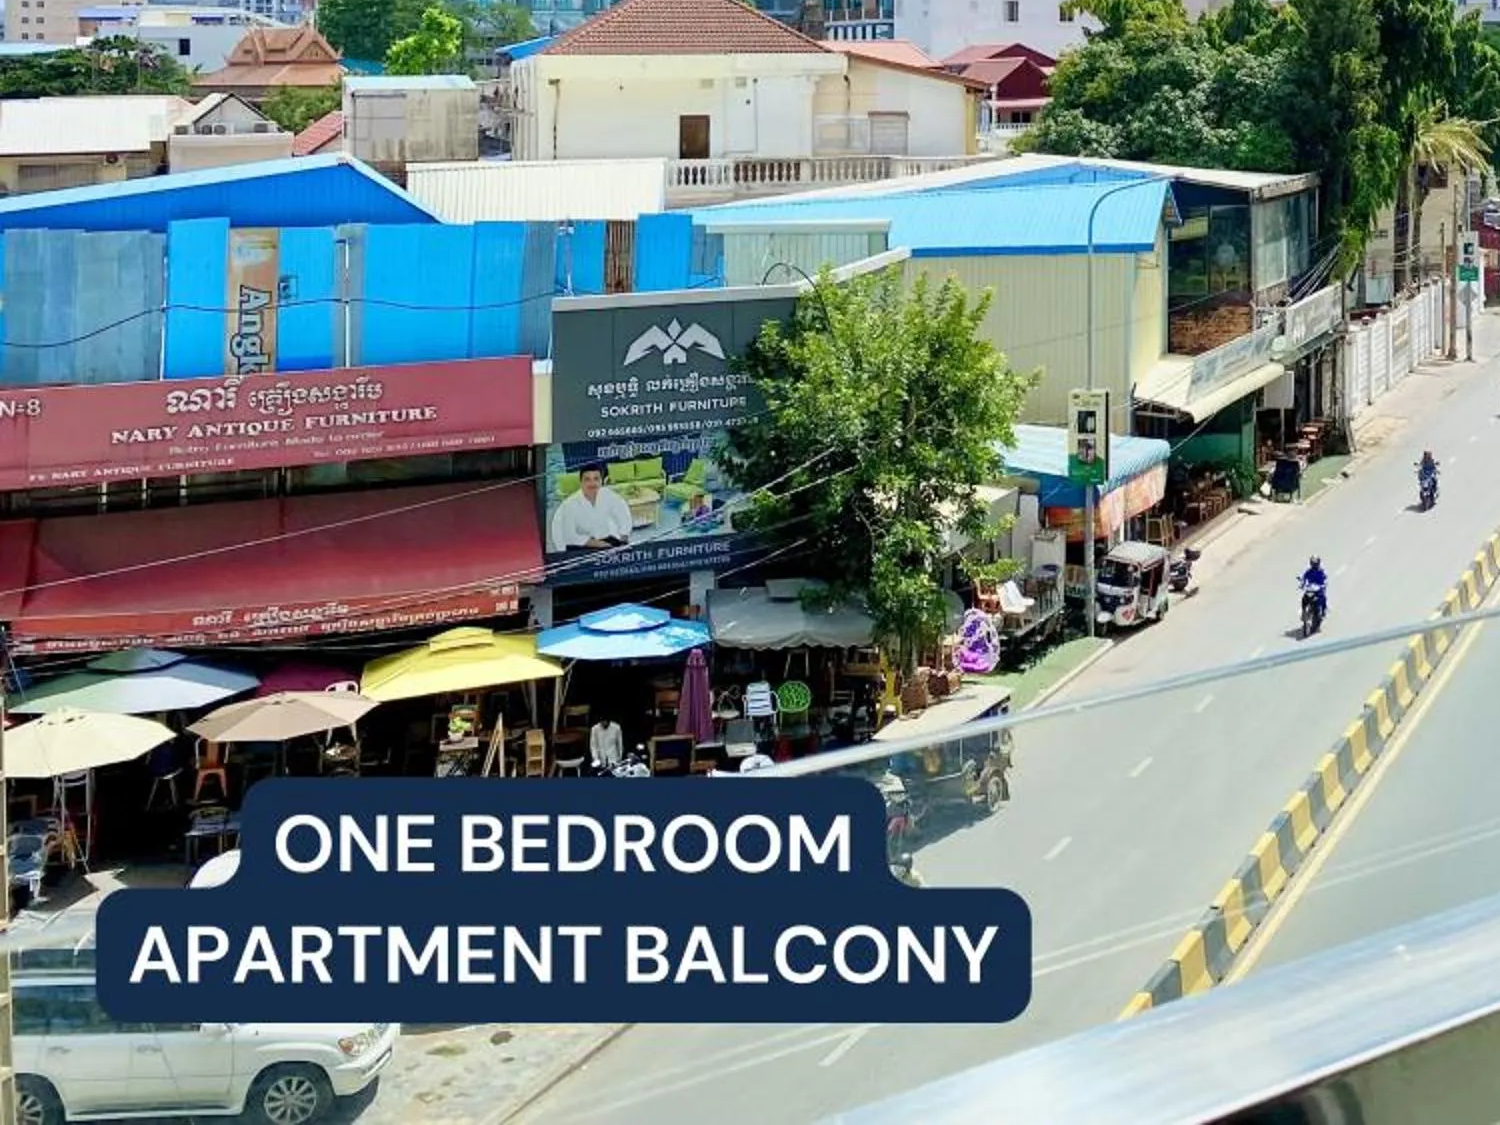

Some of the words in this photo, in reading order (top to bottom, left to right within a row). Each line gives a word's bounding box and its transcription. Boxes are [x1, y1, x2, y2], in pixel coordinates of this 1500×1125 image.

[601, 401, 664, 418] SOKRITH
[669, 396, 747, 413] FURNITURE
[111, 426, 178, 445] NARY
[187, 417, 295, 439] ANTIQUE
[305, 405, 438, 431] FURNITURE
[657, 542, 731, 560] FURNITURE
